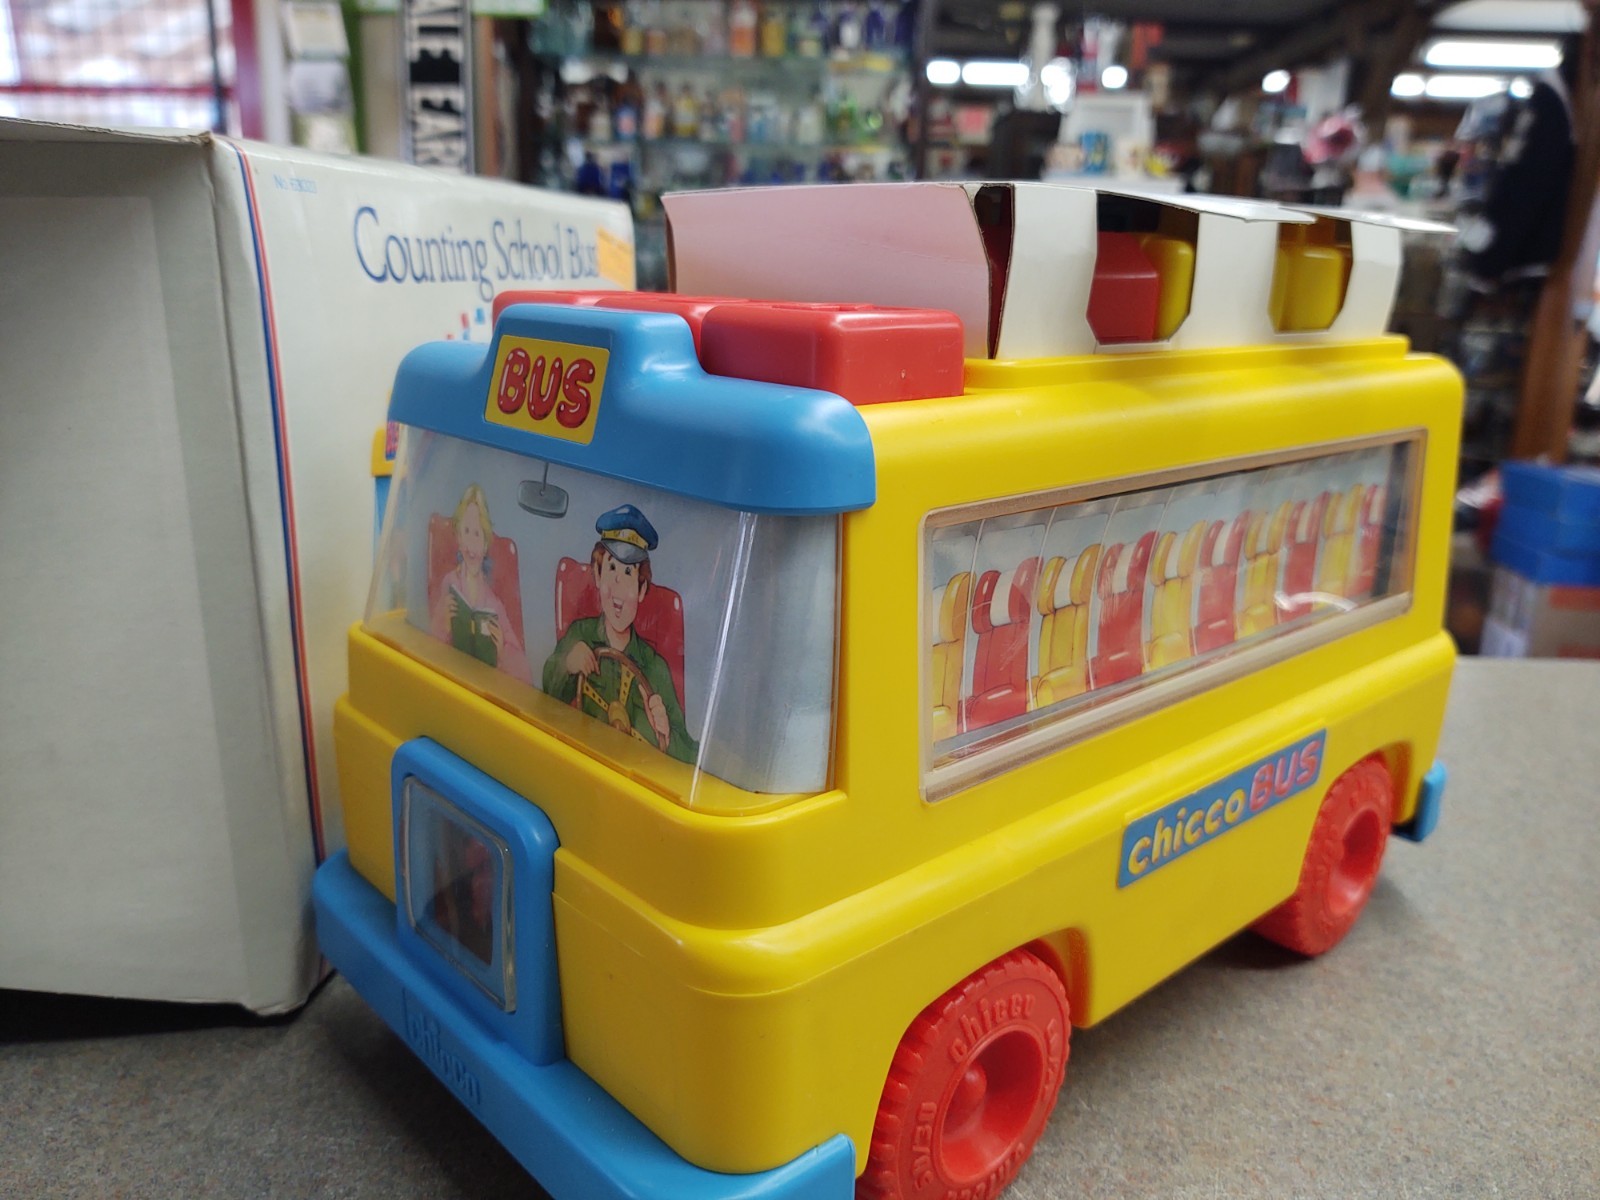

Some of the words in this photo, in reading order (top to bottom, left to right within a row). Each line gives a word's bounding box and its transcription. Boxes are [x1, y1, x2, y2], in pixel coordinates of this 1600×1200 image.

[353, 205, 494, 303] Counting
[492, 218, 565, 282] School
[497, 347, 596, 429] BUS
[1127, 788, 1247, 876] chicco
[1249, 739, 1321, 813] BUS
[950, 992, 1036, 1063] chicco
